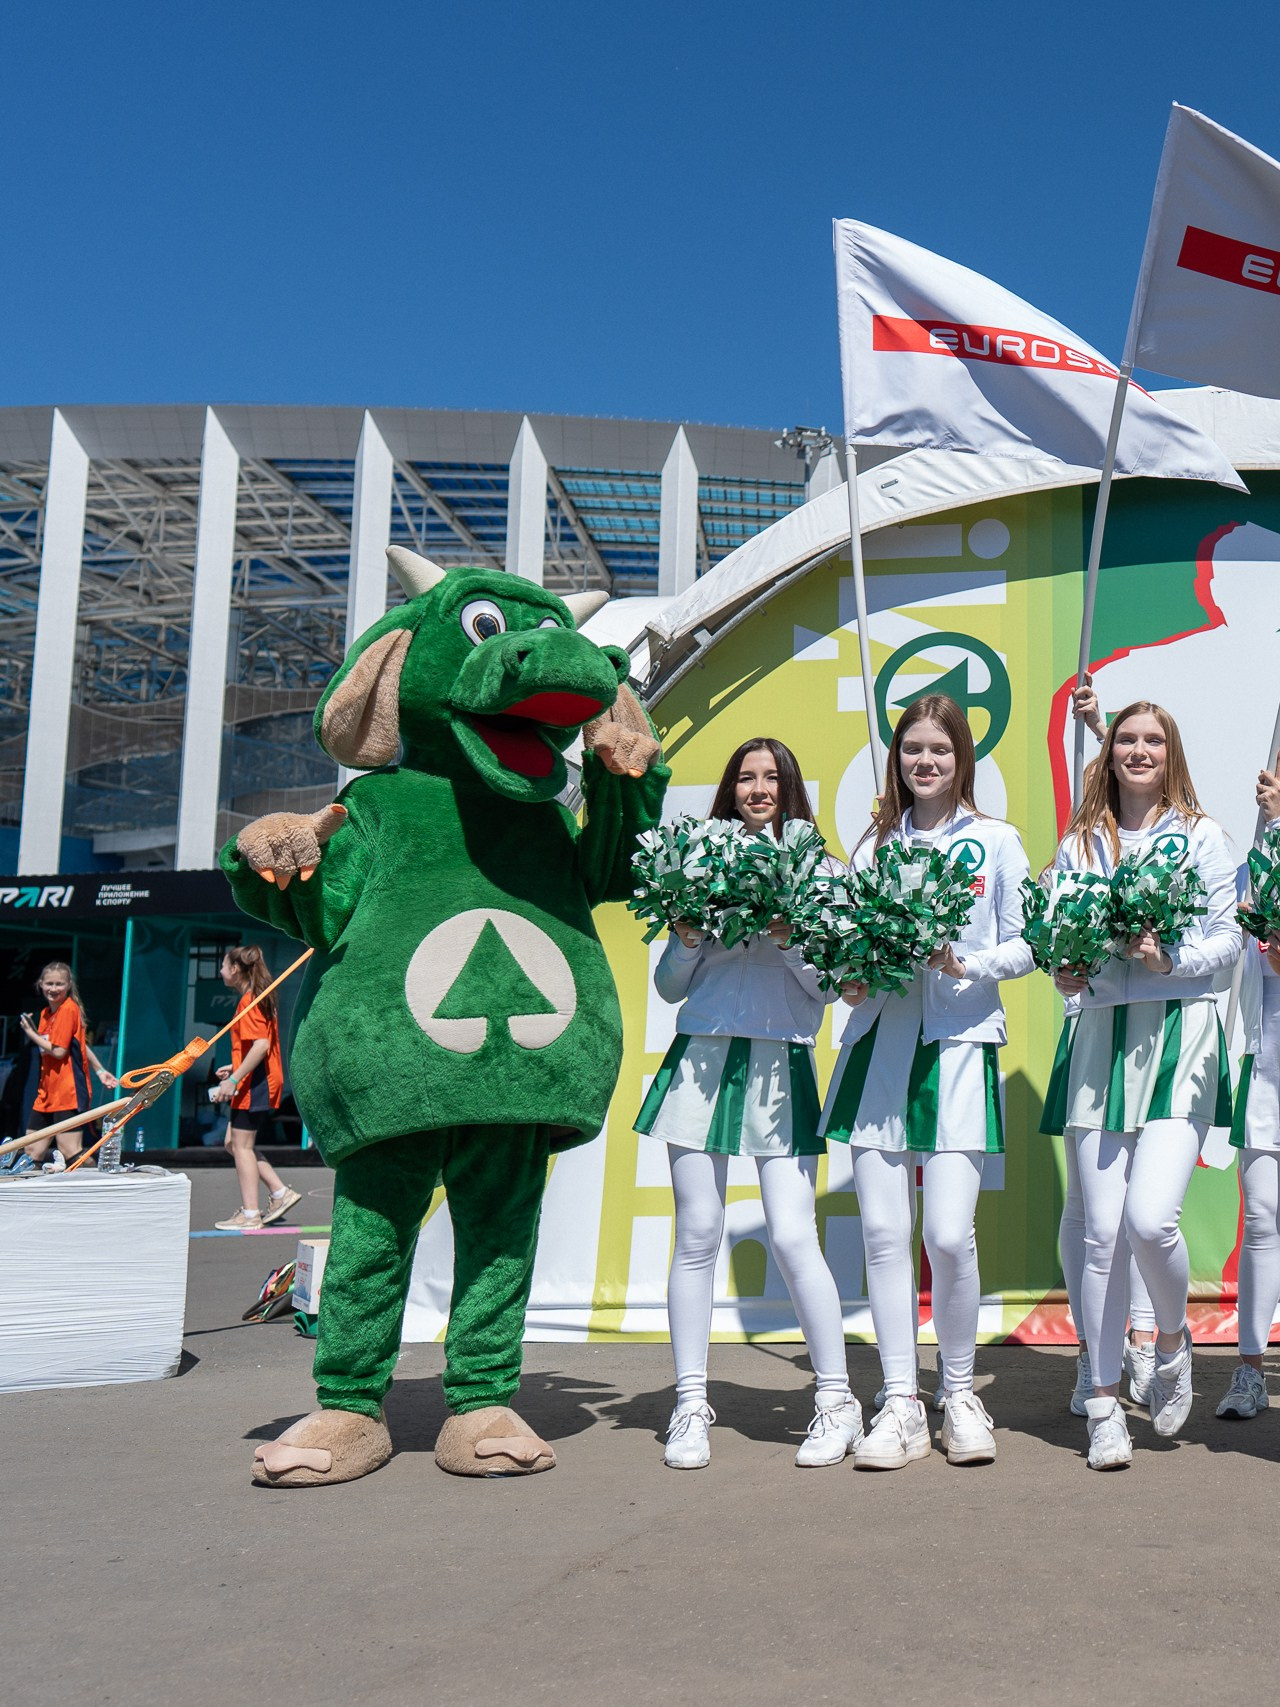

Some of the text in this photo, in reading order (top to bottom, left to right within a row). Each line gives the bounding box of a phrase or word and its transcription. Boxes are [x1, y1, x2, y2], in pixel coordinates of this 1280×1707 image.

[101, 884, 132, 892] ЛУЧШЕЕ
[98, 890, 150, 899] ПРИЛОЖЕНИЕ
[102, 898, 132, 907] СПОРТУ
